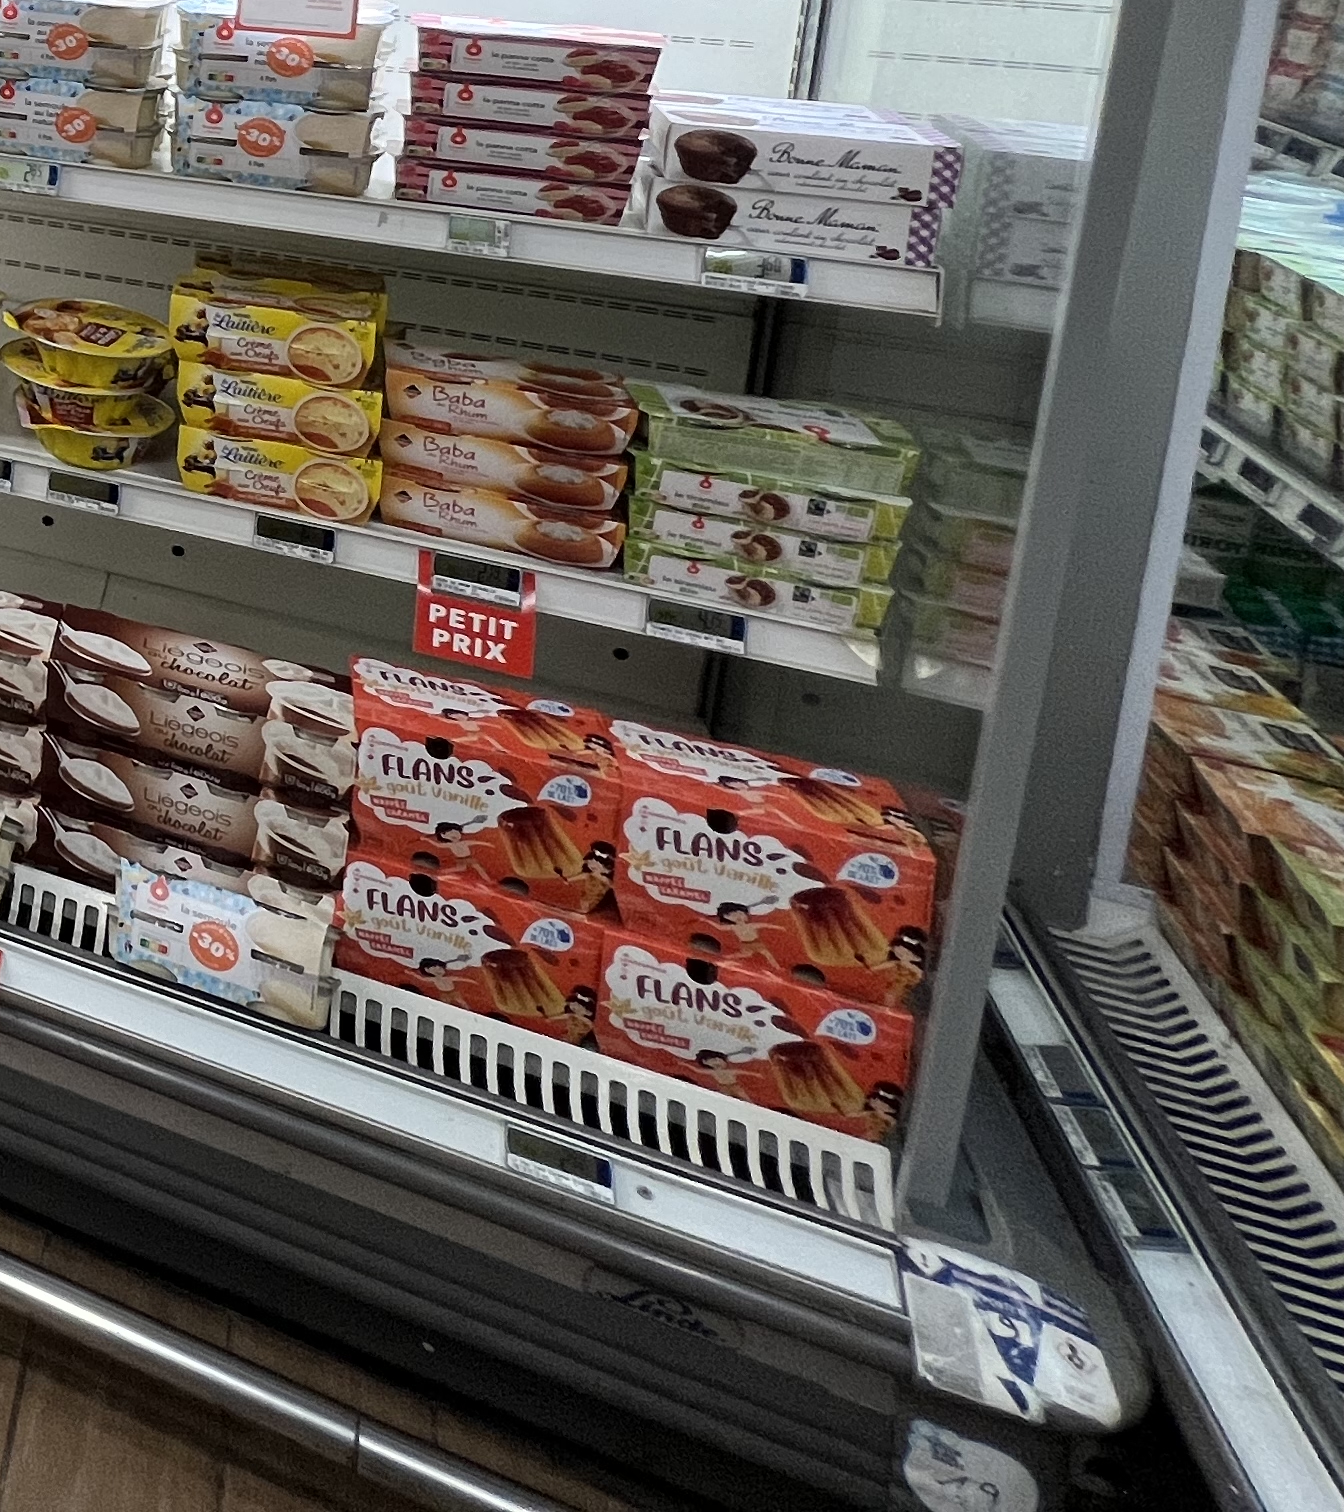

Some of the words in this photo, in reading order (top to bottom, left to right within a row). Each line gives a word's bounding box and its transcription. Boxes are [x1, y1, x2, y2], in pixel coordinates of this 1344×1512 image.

[769, 142, 827, 167] Bonne
[827, 149, 901, 174] Maman
[749, 199, 805, 224] Bonne
[806, 207, 879, 232] Maman
[433, 385, 486, 408] Baba
[448, 404, 488, 420] Rhum
[424, 436, 476, 461] Baba
[439, 455, 478, 472] Rhum
[423, 492, 476, 517] Baba
[438, 512, 478, 528] Rhum
[429, 603, 519, 639] PETIT
[143, 639, 264, 679] Liégeois
[432, 628, 507, 663] PRIX
[161, 659, 253, 691] chocolat
[149, 709, 239, 749] Liégeois
[164, 734, 232, 764] chocolat
[381, 754, 475, 788] FLANS
[143, 787, 232, 828] Liégeois
[157, 810, 225, 842] chocolat
[656, 826, 763, 867] FLANS
[366, 888, 459, 928] FLANS
[636, 975, 743, 1018] FLANS
